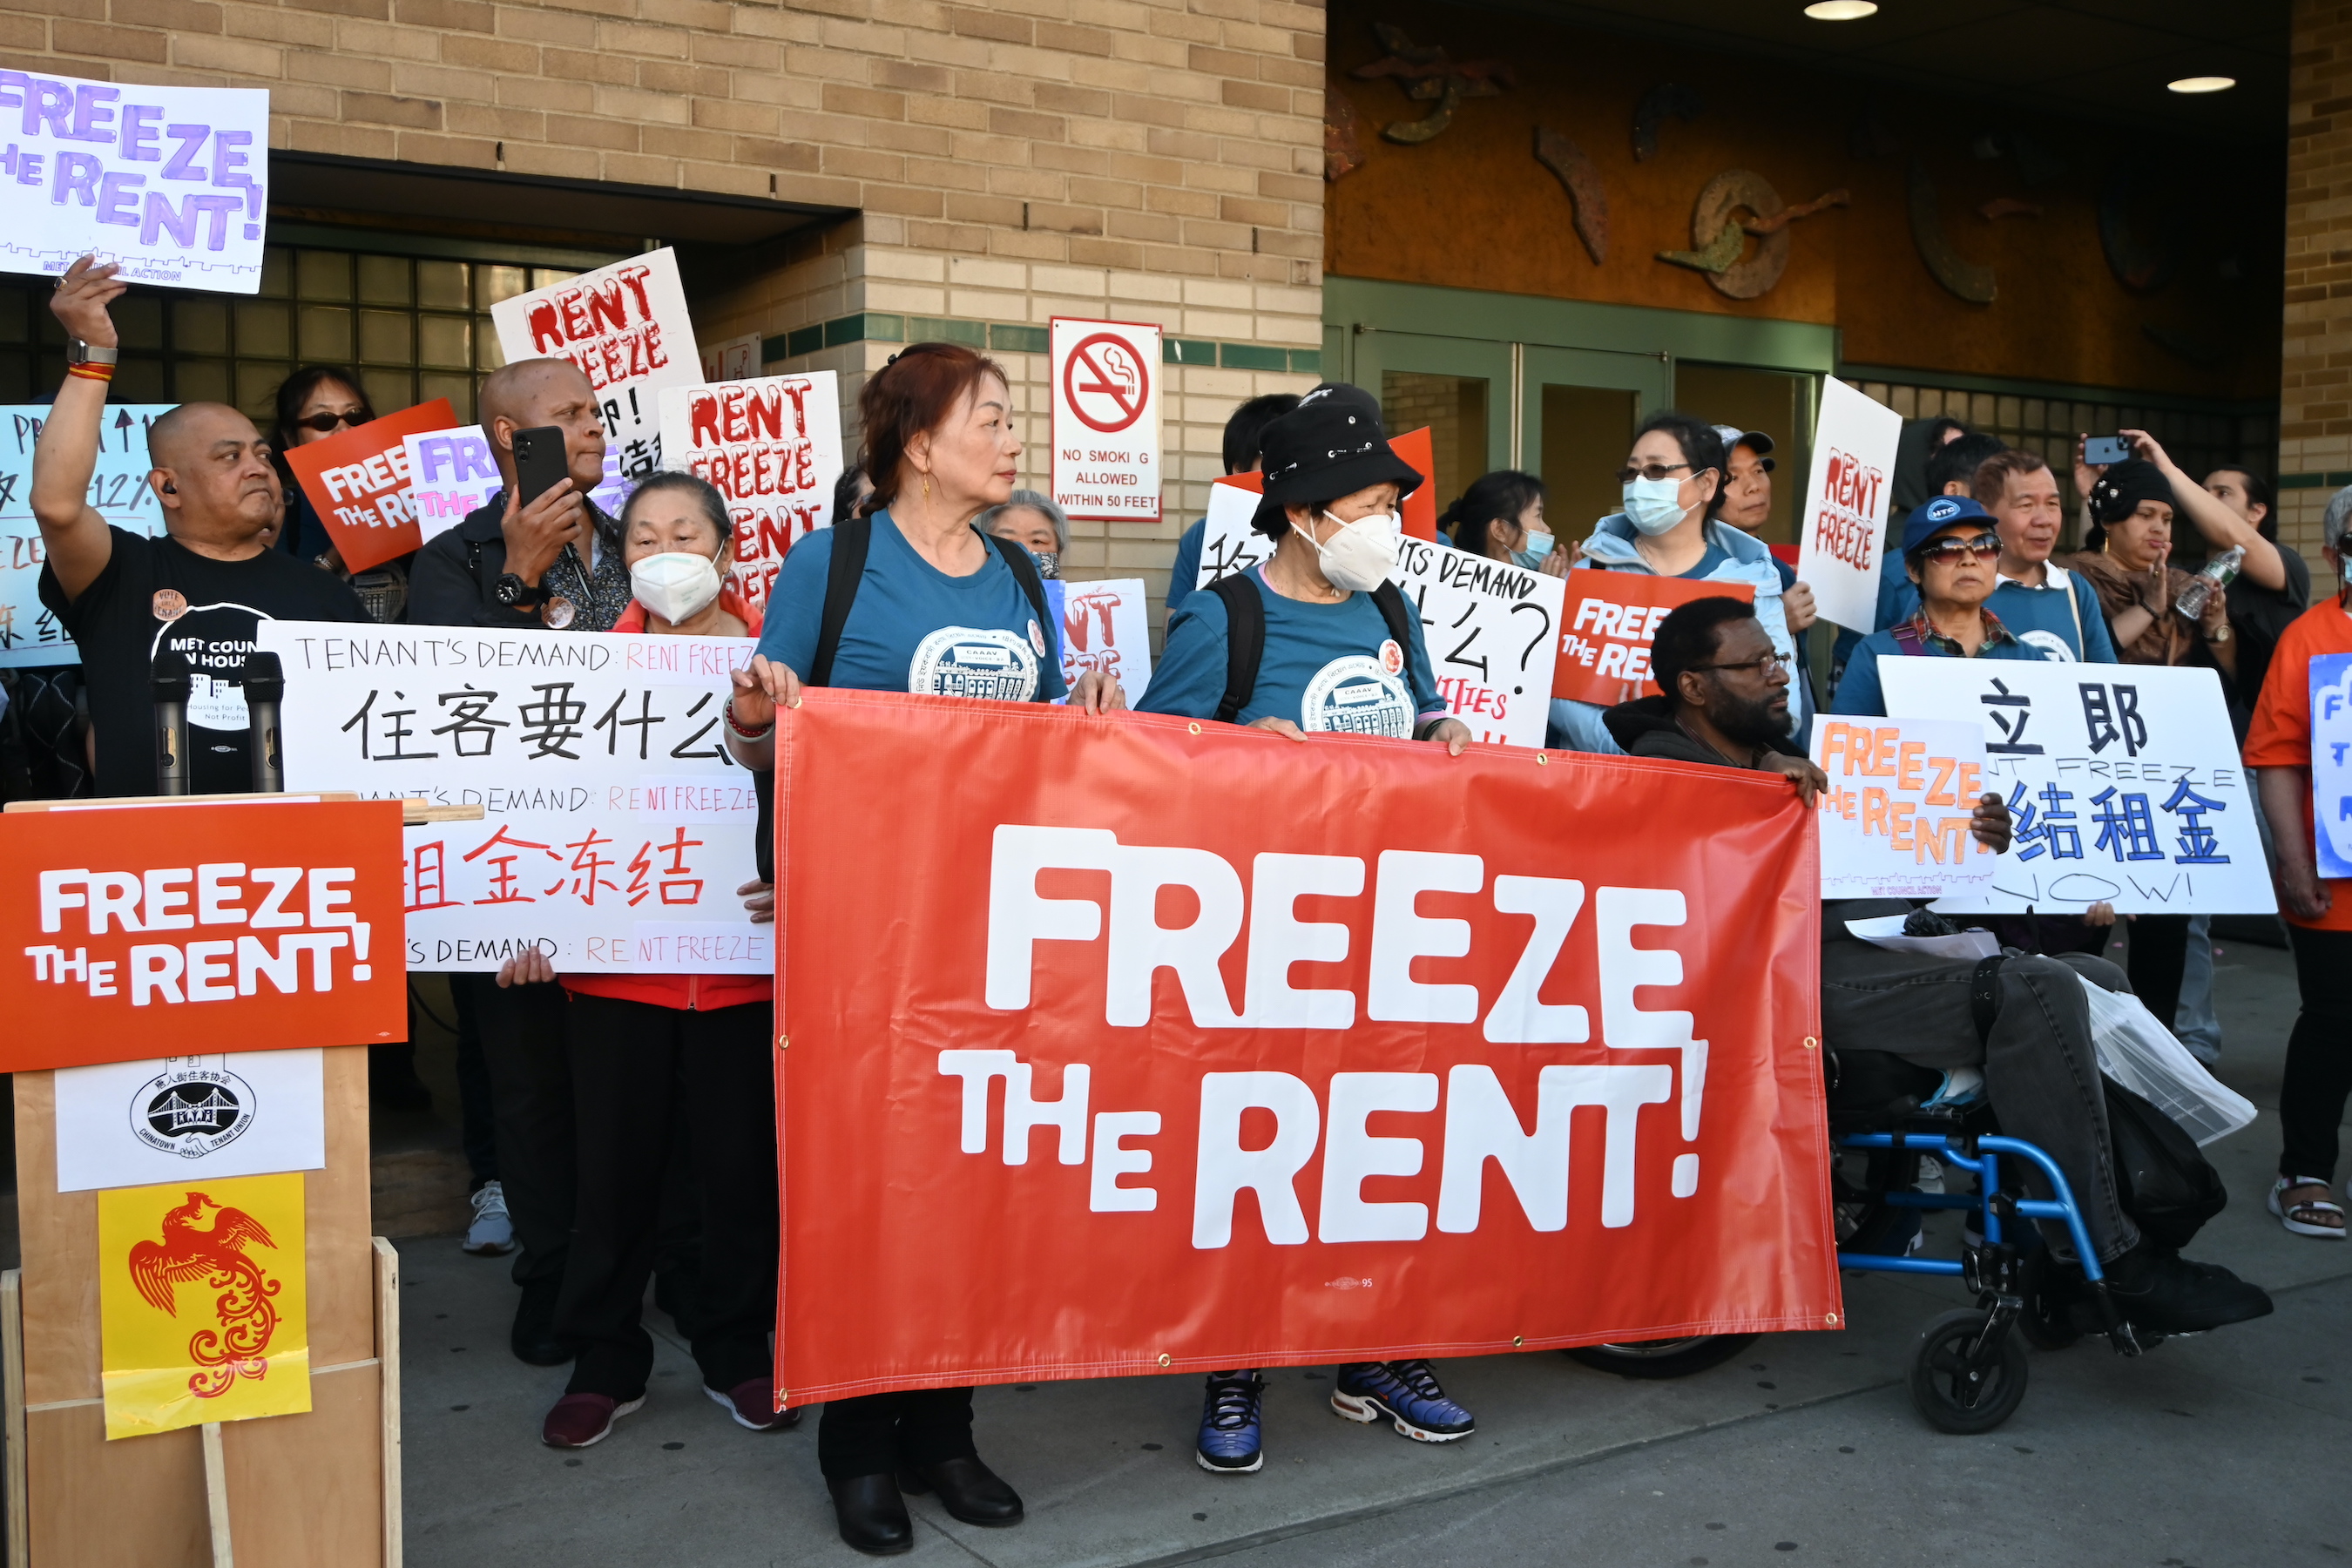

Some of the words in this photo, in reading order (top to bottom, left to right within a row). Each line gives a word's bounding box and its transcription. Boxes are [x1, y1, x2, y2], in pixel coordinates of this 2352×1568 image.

[0, 144, 44, 186] HE
[51, 151, 263, 251] RENT!
[44, 261, 70, 272] MET
[131, 267, 182, 280] ACTION
[524, 265, 652, 354] RENT
[687, 379, 812, 449] RENT
[321, 445, 411, 503] FREE
[686, 437, 816, 502] FREEZE
[1063, 449, 1081, 461] NO
[1089, 450, 1149, 464] SMOKIG
[1076, 472, 1138, 485] ALLOWED
[1825, 446, 1882, 518] RENT
[333, 505, 382, 528] THE
[418, 491, 478, 518] THE
[1058, 493, 1103, 506] WITHIN
[1107, 495, 1120, 507] 50
[1125, 496, 1156, 508] FEET
[1932, 507, 1955, 517] HTC
[728, 499, 821, 563] ENT
[1816, 500, 1874, 571] FREEZE
[1439, 551, 1537, 599] DEMAND
[159, 591, 179, 601] VOTE
[1064, 593, 1121, 652] NT
[1573, 598, 1673, 640] FREE
[170, 638, 205, 651] MET
[208, 640, 258, 653] COUN
[294, 639, 467, 671] TENANT'S
[626, 643, 680, 672] RENT
[689, 644, 754, 675] FREEZ
[1563, 634, 1598, 666] THE
[1344, 686, 1372, 695] CAAAV
[341, 682, 734, 766] 住客要什么
[1820, 722, 1982, 809] FREEZE
[2055, 758, 2236, 787] FREEZE
[609, 787, 667, 811] RENT
[675, 786, 756, 811] FREEZE
[1818, 785, 1856, 820] HE
[2006, 774, 2232, 864] 结租金
[39, 862, 356, 935] FREEZE
[1870, 886, 1885, 896] MET
[1887, 886, 1916, 896] COUNCIL
[1917, 885, 1943, 896] ACTION
[587, 936, 670, 963] RENT
[677, 936, 765, 963] FREEZE
[985, 824, 1695, 1049] FREEZE
[24, 945, 118, 997] THE
[130, 922, 372, 1006] RENT!
[139, 1128, 176, 1150] CHINATOWN
[210, 1130, 235, 1148] TENANT
[233, 1113, 251, 1132] UNION
[938, 1049, 1162, 1213] THE
[1191, 1039, 1709, 1249] RENT!
[1362, 1278, 1373, 1288] 95
